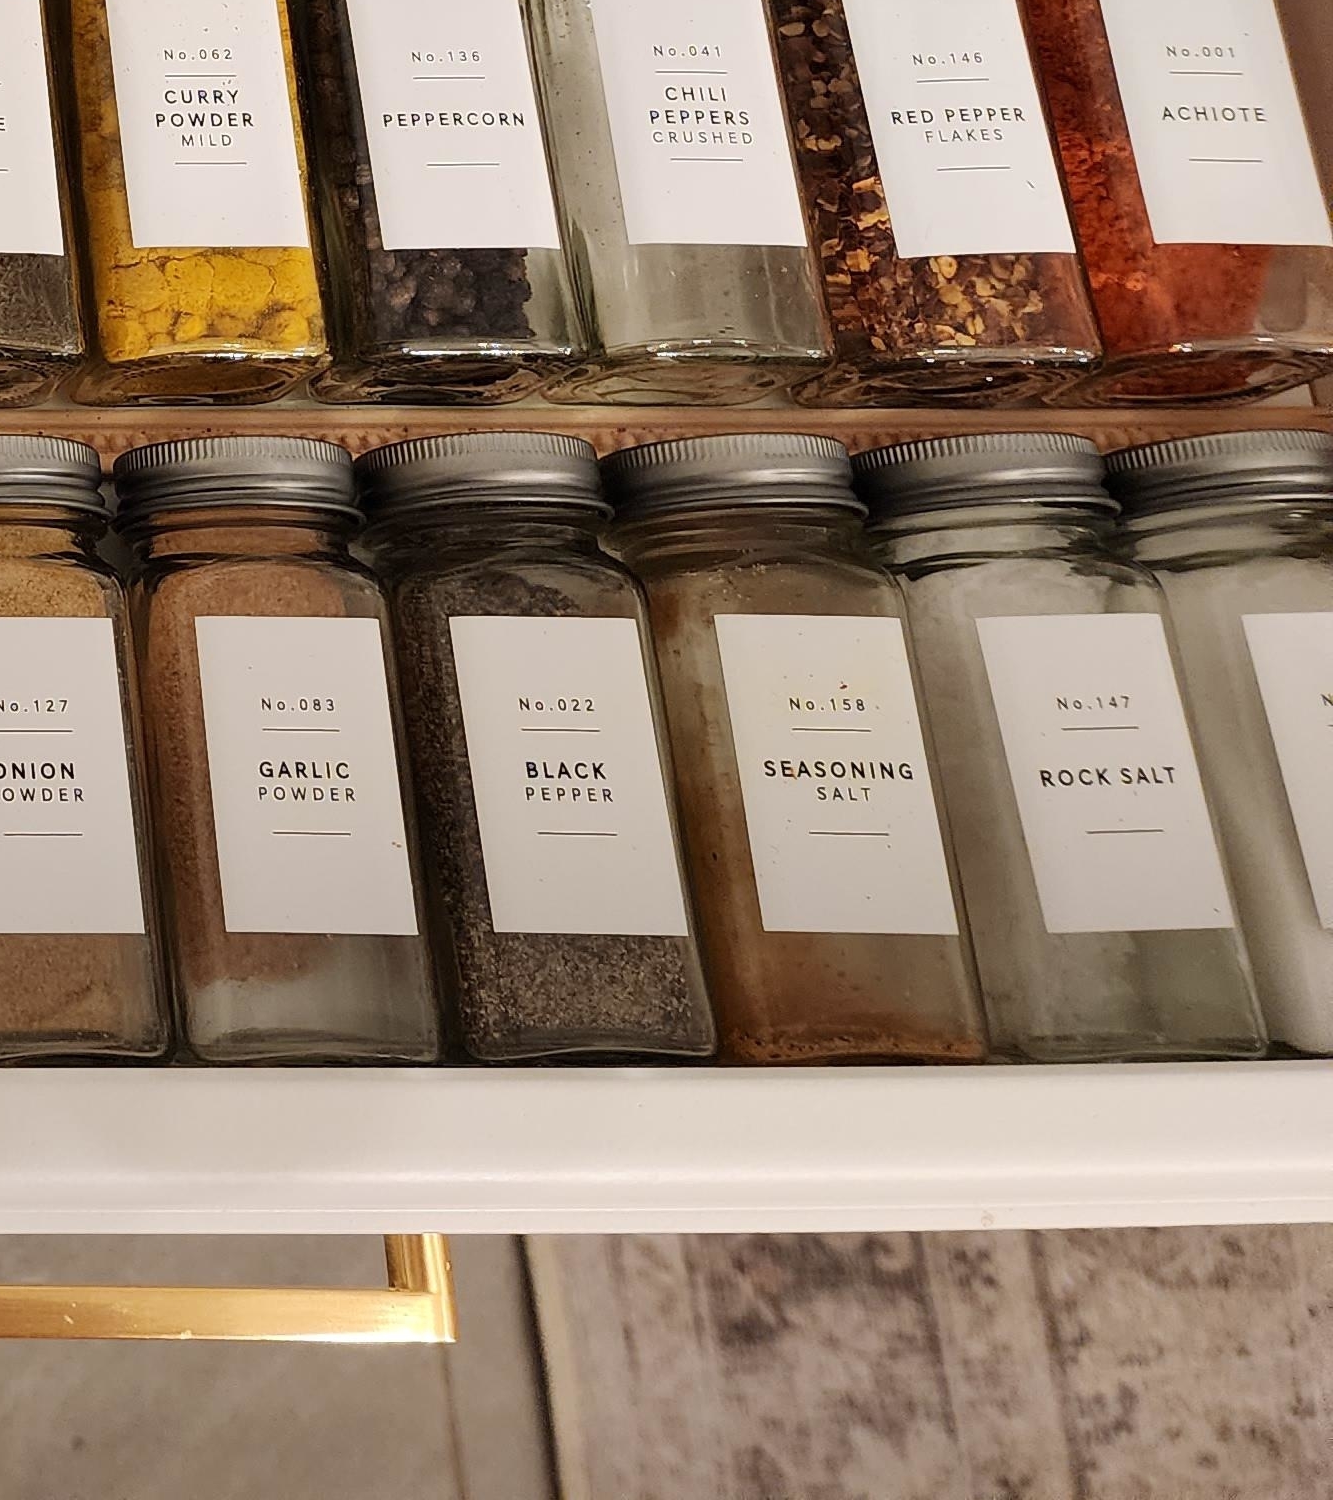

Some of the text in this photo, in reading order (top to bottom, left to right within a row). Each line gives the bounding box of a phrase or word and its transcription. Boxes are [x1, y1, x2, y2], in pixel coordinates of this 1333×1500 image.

[163, 48, 233, 61] No.062
[411, 50, 480, 63] No.136
[653, 45, 721, 58] No.041
[912, 51, 983, 66] No.146
[1165, 45, 1235, 58] No.001
[164, 89, 239, 105] CURRY
[664, 86, 727, 102] CHILI
[155, 112, 254, 128] POWDER
[382, 112, 525, 128] PEPPERCORN
[649, 109, 750, 126] PEPPERS
[890, 107, 1026, 125] RED PEPPER
[1161, 106, 1267, 122] ACHIOTE
[181, 134, 232, 147] MILD
[652, 131, 753, 145] CRUSHED
[924, 128, 1003, 144] FLAKES
[261, 697, 335, 712] No.083
[518, 697, 595, 712] No.022
[788, 697, 866, 712] No.158
[1056, 695, 1130, 711] No.147
[259, 761, 350, 780] GARLIC
[525, 761, 607, 780] BLACK
[763, 759, 914, 781] SEASONING
[1039, 766, 1175, 788] ROCK SALT
[258, 786, 356, 802] POWDER
[525, 786, 614, 803] PEPPER
[816, 786, 871, 802] SALT
